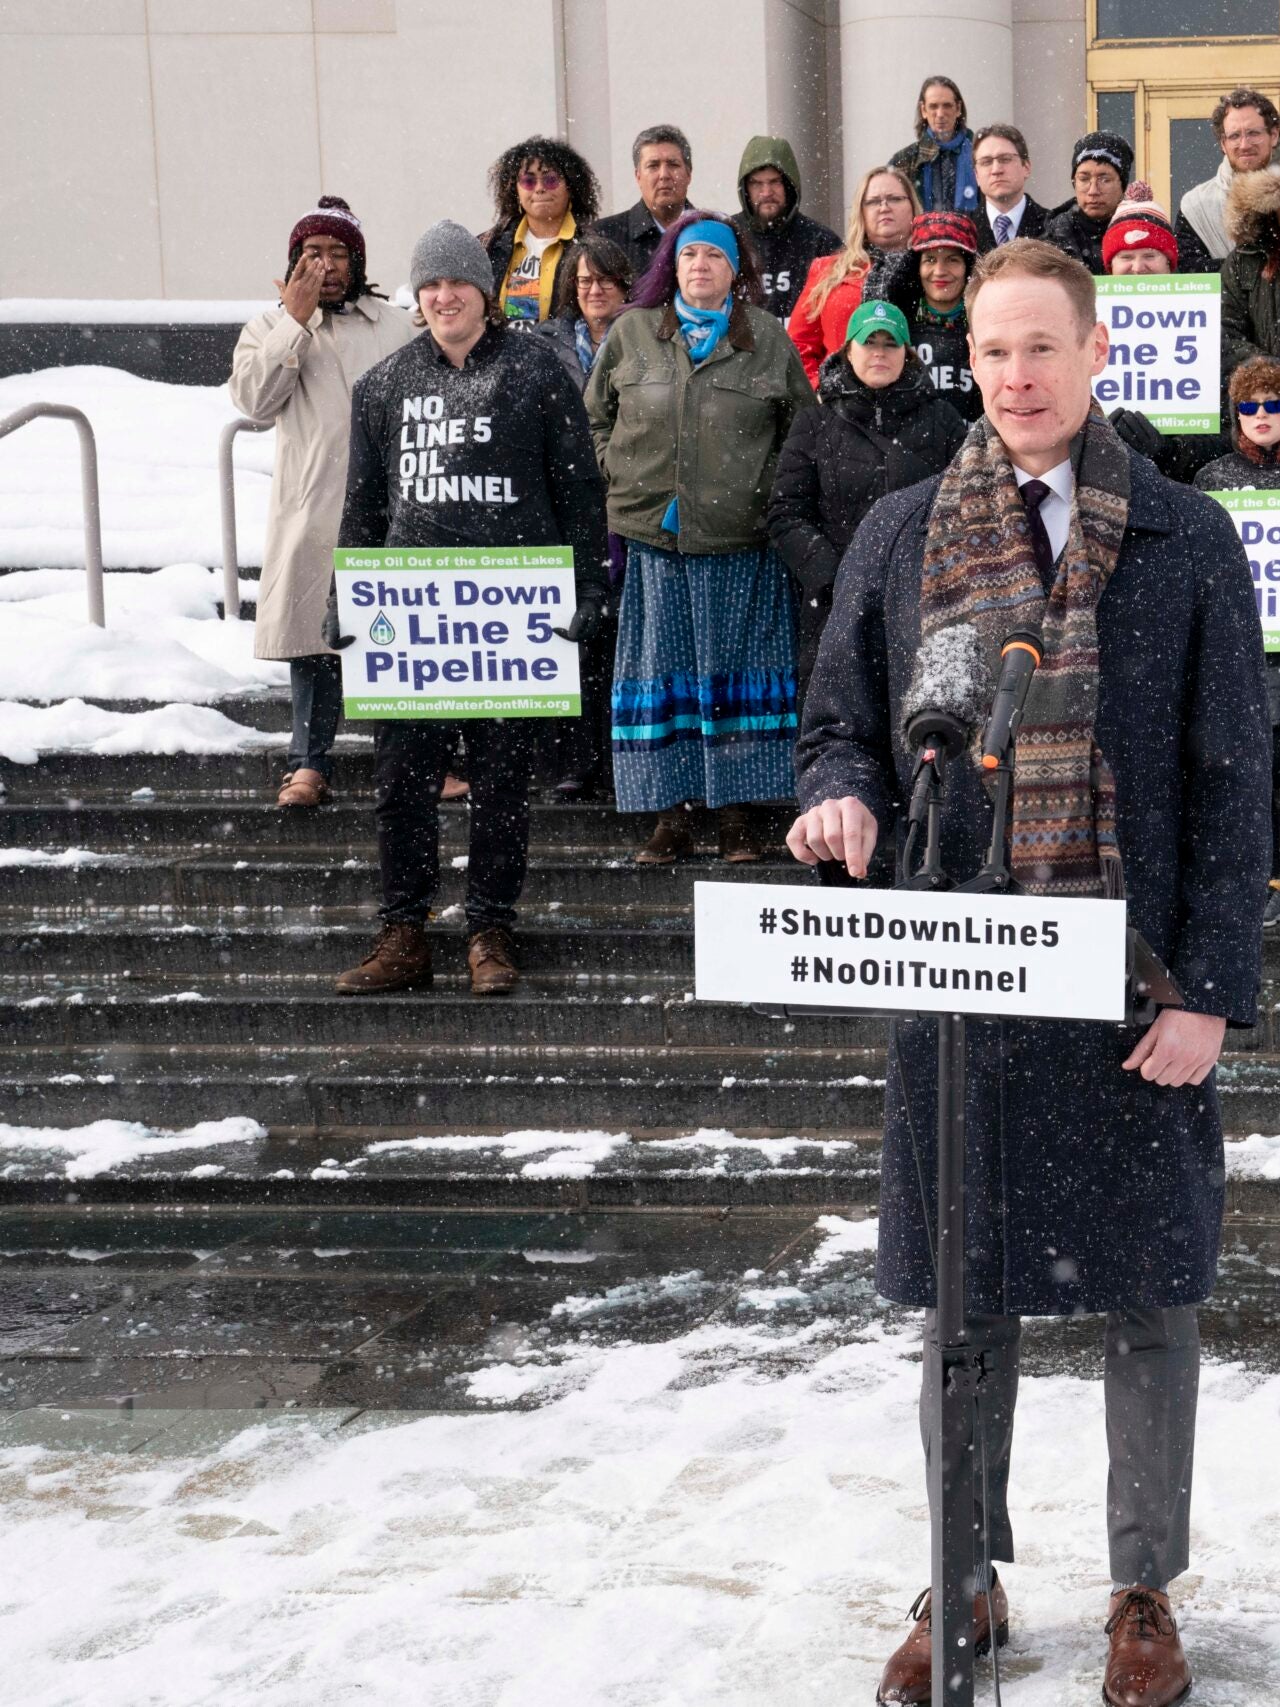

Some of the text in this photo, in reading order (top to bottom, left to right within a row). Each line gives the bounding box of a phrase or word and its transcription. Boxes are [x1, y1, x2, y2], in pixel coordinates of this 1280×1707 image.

[776, 271, 791, 292] 5
[1097, 281, 1211, 293] of the Great Lakes
[1112, 305, 1207, 329] Down
[1174, 335, 1198, 365] 5
[959, 368, 973, 392] 5
[402, 395, 444, 423] NO
[400, 416, 492, 451] LINE 5
[400, 450, 445, 479] OIL
[400, 475, 518, 503] TUNNEL
[1226, 498, 1239, 509] of
[1243, 497, 1263, 508] the
[345, 555, 563, 569] Keep Oil Out of the Great Lakes
[351, 580, 561, 607] Shut Down
[408, 612, 553, 645] Line 5
[366, 651, 558, 691] Pipeline
[357, 700, 570, 711] www.OilandWaterDontMix.org
[759, 907, 1060, 948] #ShutDownLine5
[791, 955, 1027, 993] #NoOilTunnel
